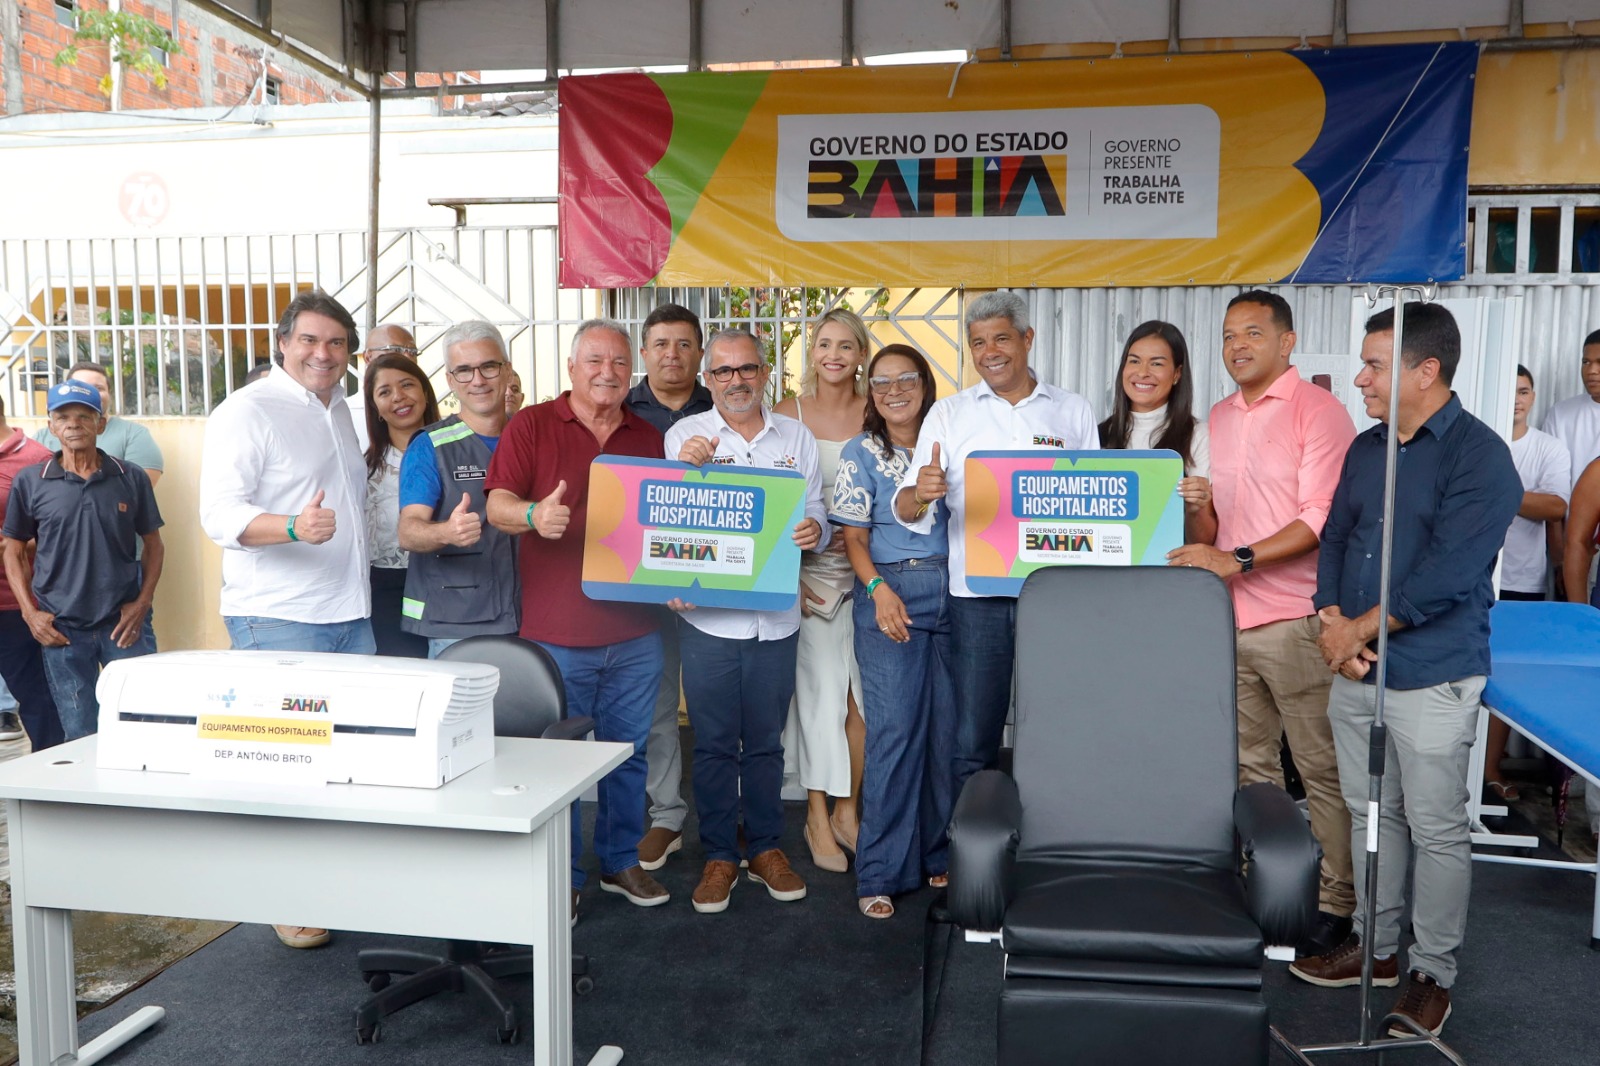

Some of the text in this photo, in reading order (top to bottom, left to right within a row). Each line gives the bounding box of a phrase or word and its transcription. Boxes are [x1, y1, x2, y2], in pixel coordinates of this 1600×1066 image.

[809, 131, 1069, 156] GOVERNO DO ESTADO
[1104, 138, 1181, 153] GOVERNO
[1104, 155, 1172, 169] PRESENTE
[807, 155, 1068, 218] BAHIA
[1103, 174, 1181, 188] TRABALHA
[125, 182, 165, 217] 70
[1103, 190, 1185, 205] PRA GENTE
[1018, 476, 1128, 496] EQUIPAMENTOS
[646, 484, 754, 510] EQUIPAMENTOS
[1022, 497, 1127, 517] HOSPITALARES
[649, 505, 752, 530] HOSPITALARES
[651, 535, 682, 543] GOVERNO
[694, 538, 719, 546] ESTADO
[1026, 534, 1093, 552] BAHIA
[650, 542, 718, 561] BAHIA
[281, 698, 328, 713] BAHIA
[202, 722, 327, 737] EQUIPAMENTOS HOSPITALARES
[214, 749, 234, 759] DEP.
[282, 753, 312, 764] BRITO
